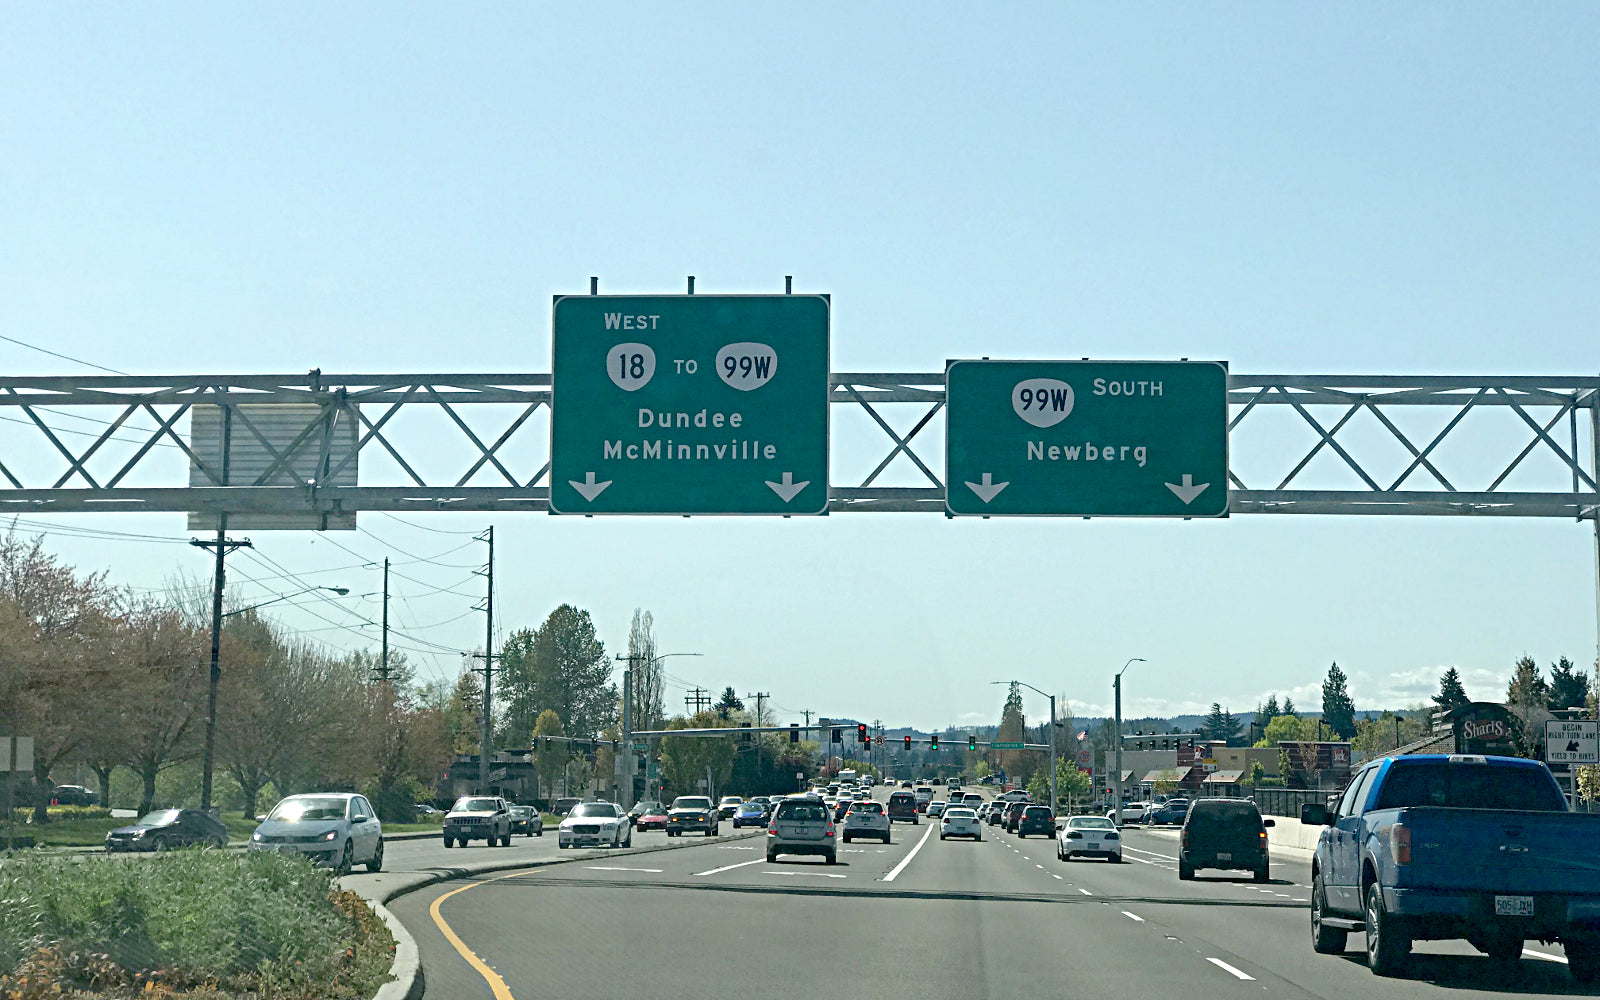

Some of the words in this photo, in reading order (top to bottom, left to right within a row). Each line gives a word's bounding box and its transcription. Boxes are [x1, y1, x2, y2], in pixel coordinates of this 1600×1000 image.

[619, 354, 645, 379] 18
[674, 360, 698, 374] TO
[724, 356, 771, 379] 99W
[1020, 388, 1068, 412] 99W
[638, 409, 743, 428] Dundee
[603, 440, 777, 460] McMinnville
[1027, 441, 1147, 467] Newberg
